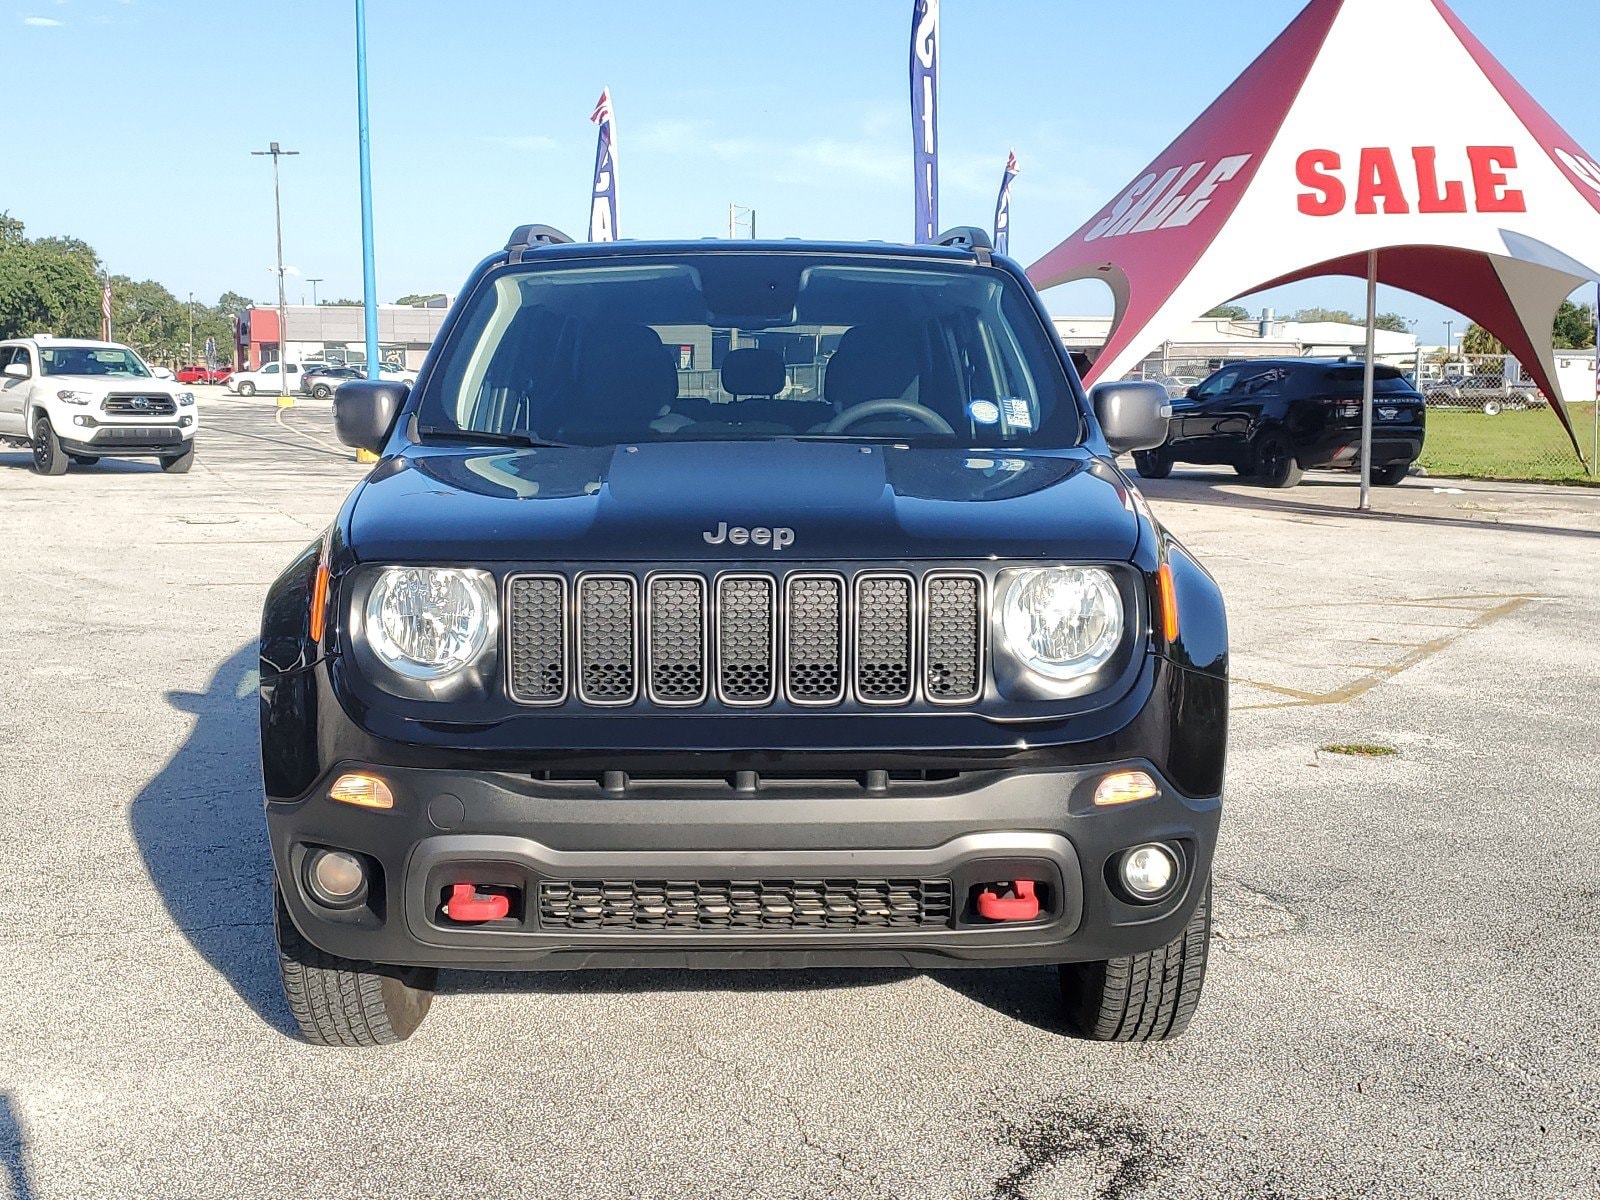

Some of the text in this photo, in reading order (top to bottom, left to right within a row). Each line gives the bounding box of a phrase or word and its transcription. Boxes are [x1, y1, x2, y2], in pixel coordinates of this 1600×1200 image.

[1083, 153, 1253, 242] SALE
[1296, 146, 1527, 216] SALE
[702, 521, 795, 550] Jeep
